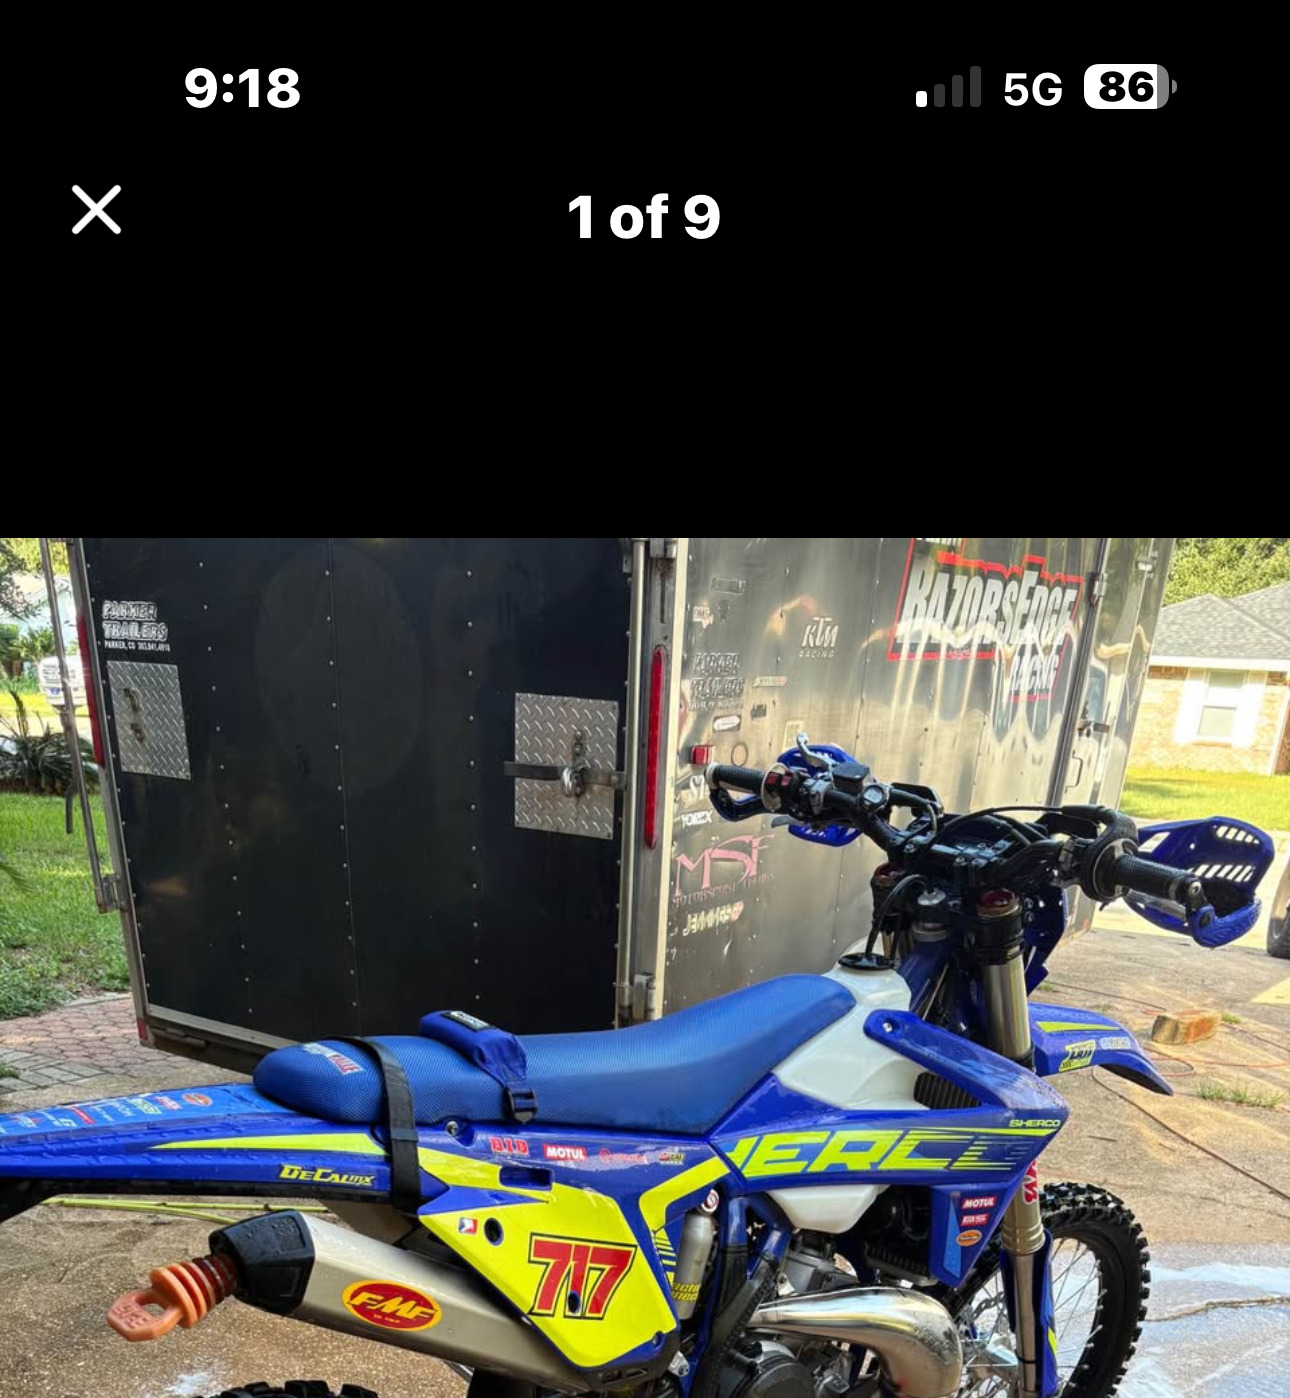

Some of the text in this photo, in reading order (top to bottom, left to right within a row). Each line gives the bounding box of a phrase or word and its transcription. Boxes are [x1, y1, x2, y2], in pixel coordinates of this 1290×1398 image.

[102, 620, 168, 641] TRAILERS
[802, 617, 839, 648] KTM
[1009, 1118, 1061, 1128] SHERCO
[546, 1146, 586, 1161] MOTUL
[963, 1199, 995, 1209] MOTUL
[528, 1232, 637, 1320] 717
[350, 1291, 438, 1320] FMF
